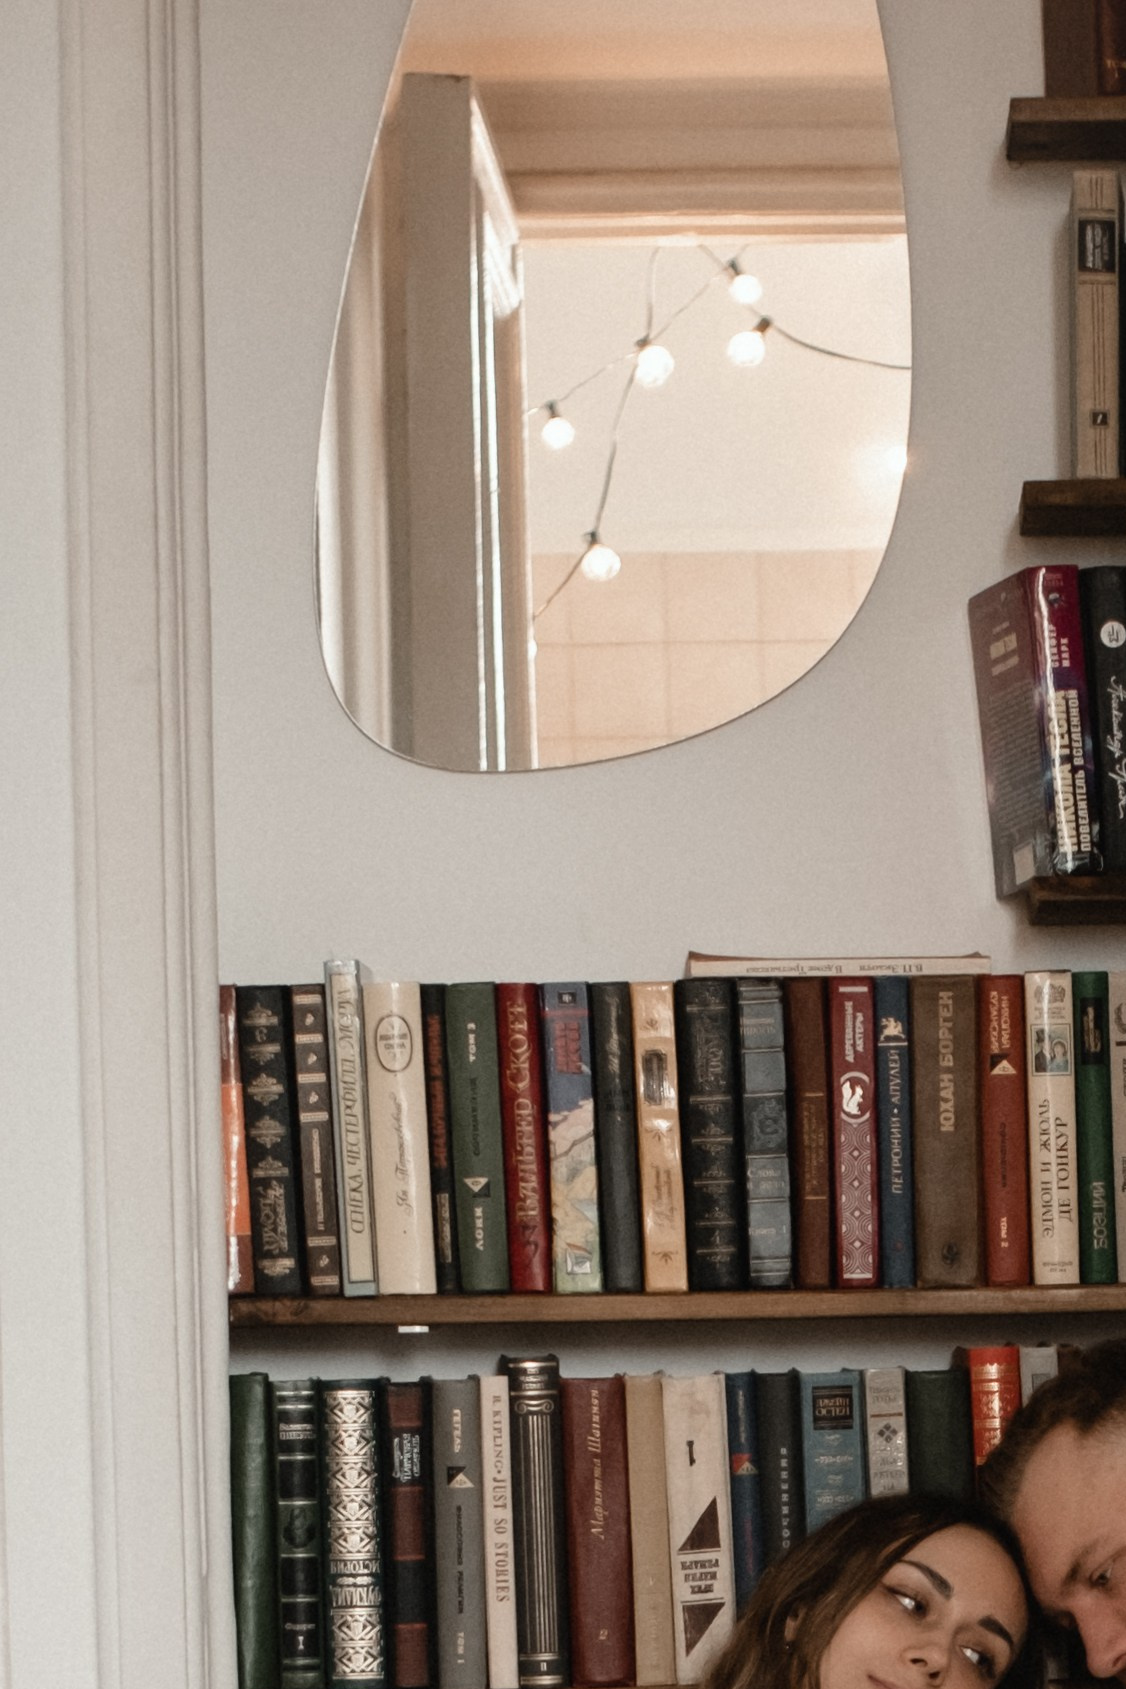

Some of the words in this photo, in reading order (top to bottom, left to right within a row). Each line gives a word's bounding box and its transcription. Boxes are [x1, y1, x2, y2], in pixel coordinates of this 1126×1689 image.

[1066, 690, 1085, 765] ВСЕЛЕННОЙ
[1074, 769, 1091, 852] ПОВЕЛИТЕЛЬ
[855, 1011, 865, 1053] АКТЕРЫ
[938, 990, 955, 1067] БОРГЕН
[999, 994, 1011, 1049] НИКОЛАЙ
[887, 1048, 902, 1103] АПУЛЕЙ
[939, 1073, 956, 1132] ЮХАН
[1037, 1098, 1051, 1154] ЖЮЛЬ
[1054, 1116, 1071, 1190] ГОНКУР
[888, 1116, 904, 1194] ПЕТРОНИЙ
[1040, 1161, 1053, 1173] И
[1039, 1180, 1055, 1239] ЭДМОН
[1057, 1198, 1073, 1223] ДЕ
[493, 1410, 504, 1469] KIPLING
[587, 1388, 602, 1453] Шагинян
[492, 1476, 508, 1511] JUST
[589, 1457, 609, 1541] Мариэтта
[493, 1518, 508, 1536] SO
[330, 1560, 380, 1575] ИСТОРИЯ
[330, 1585, 381, 1607] ФУКИДИД
[494, 1541, 511, 1603] STORIES
[684, 1571, 719, 1584] МАРИЯ
